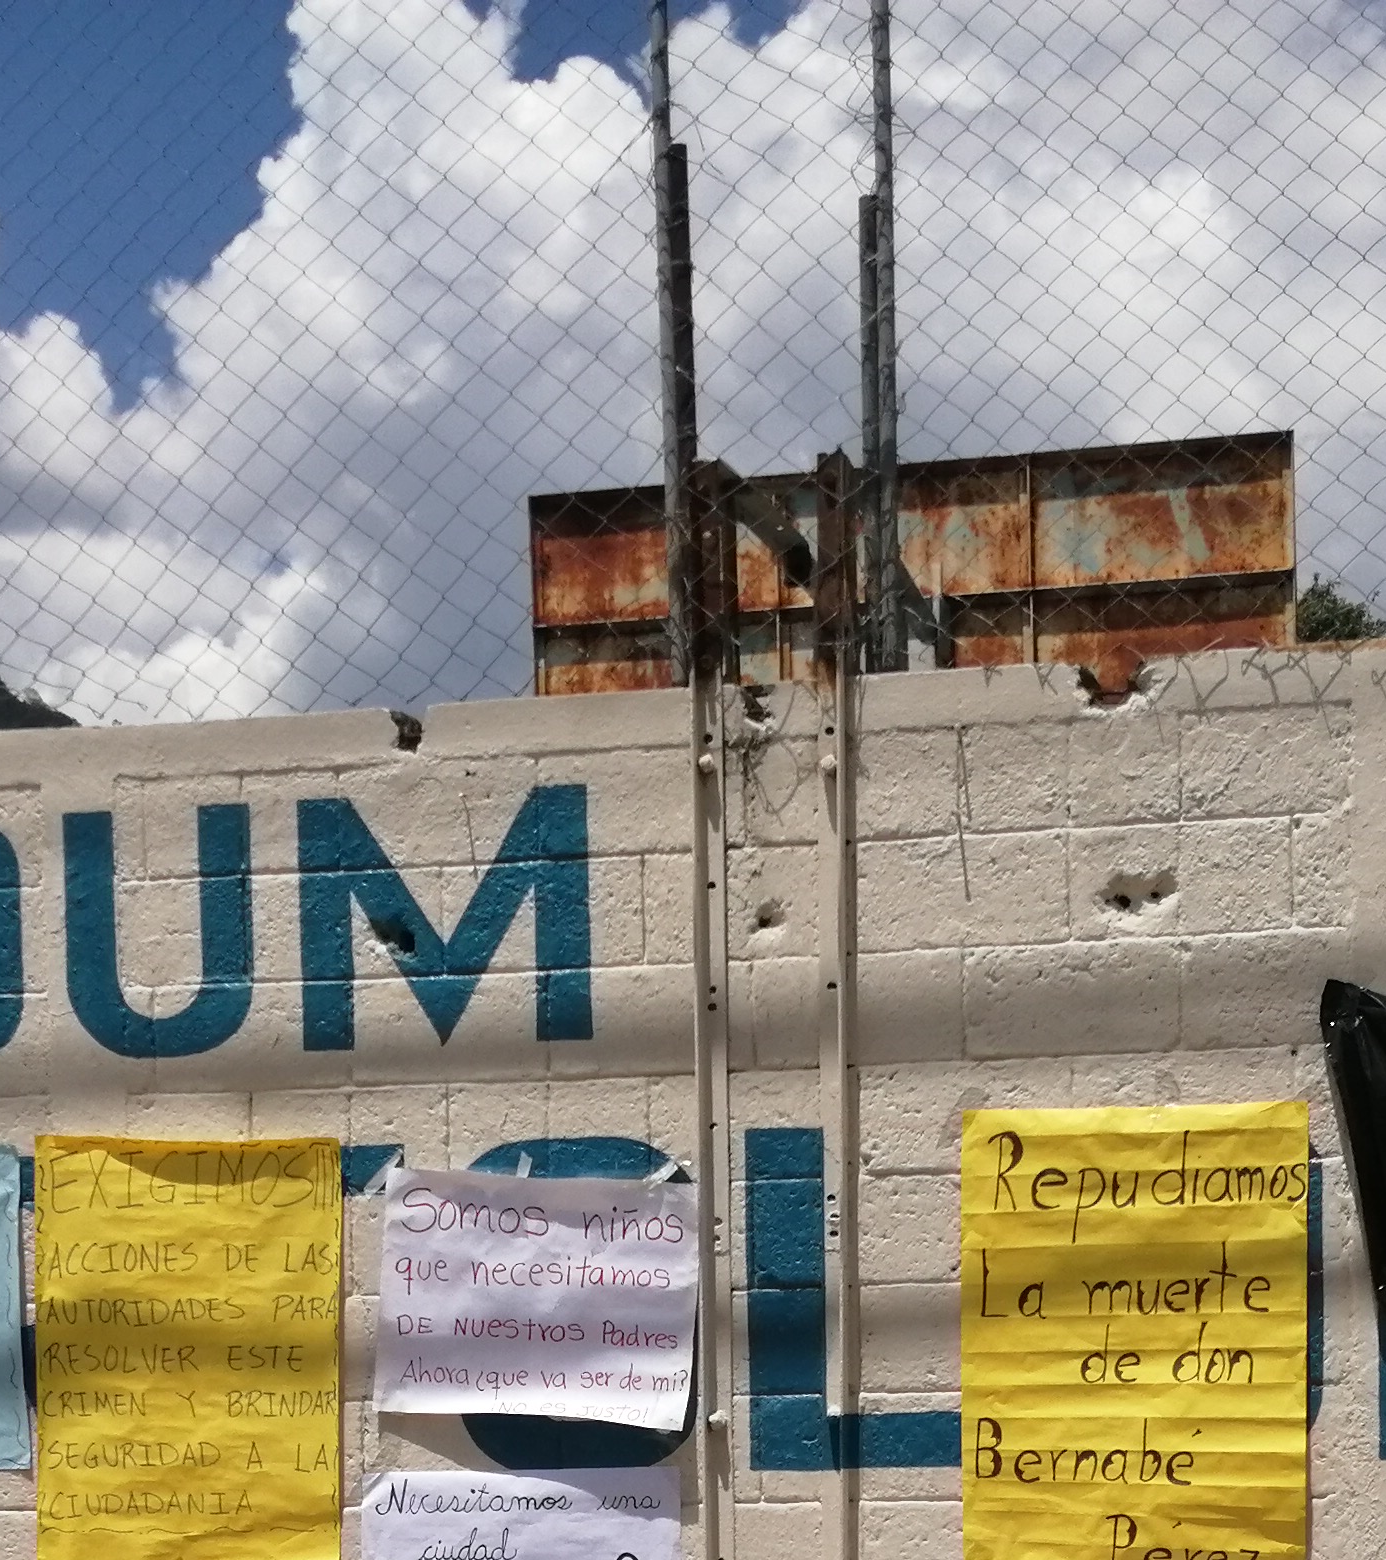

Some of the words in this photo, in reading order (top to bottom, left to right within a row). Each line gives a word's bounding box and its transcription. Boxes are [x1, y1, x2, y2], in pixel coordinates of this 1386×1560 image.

[987, 1129, 1308, 1244] Repudiamos
[400, 1187, 550, 1237] Somos
[582, 1205, 685, 1244] niños
[47, 1241, 200, 1279] ACCIONES
[223, 1242, 258, 1274] DE
[283, 1241, 334, 1274] LAS
[395, 1256, 450, 1296] que
[471, 1256, 672, 1289] necesitamos
[979, 1248, 1048, 1320] La
[1080, 1240, 1273, 1317] muerte
[43, 1297, 246, 1327] AUTORIDADES
[272, 1293, 338, 1323] PARA
[397, 1314, 433, 1337] DE
[602, 1318, 680, 1350] Padres
[42, 1341, 200, 1376] RESOLVER
[226, 1344, 304, 1373] ESTE
[1079, 1323, 1143, 1385] de
[1171, 1320, 1254, 1385] don
[399, 1356, 470, 1386] Ahora
[540, 1370, 568, 1391] va
[579, 1370, 612, 1390] ser
[619, 1361, 643, 1393] de
[42, 1389, 148, 1419] CRIMEN
[177, 1391, 199, 1419] Y
[225, 1388, 337, 1420] BRINDAR
[47, 1441, 222, 1471] SEGURIDAD
[245, 1441, 264, 1471] A
[294, 1442, 330, 1473] LA
[973, 1416, 1205, 1488] Bernabé
[375, 1479, 575, 1517] Necesitamos
[597, 1495, 662, 1512] una
